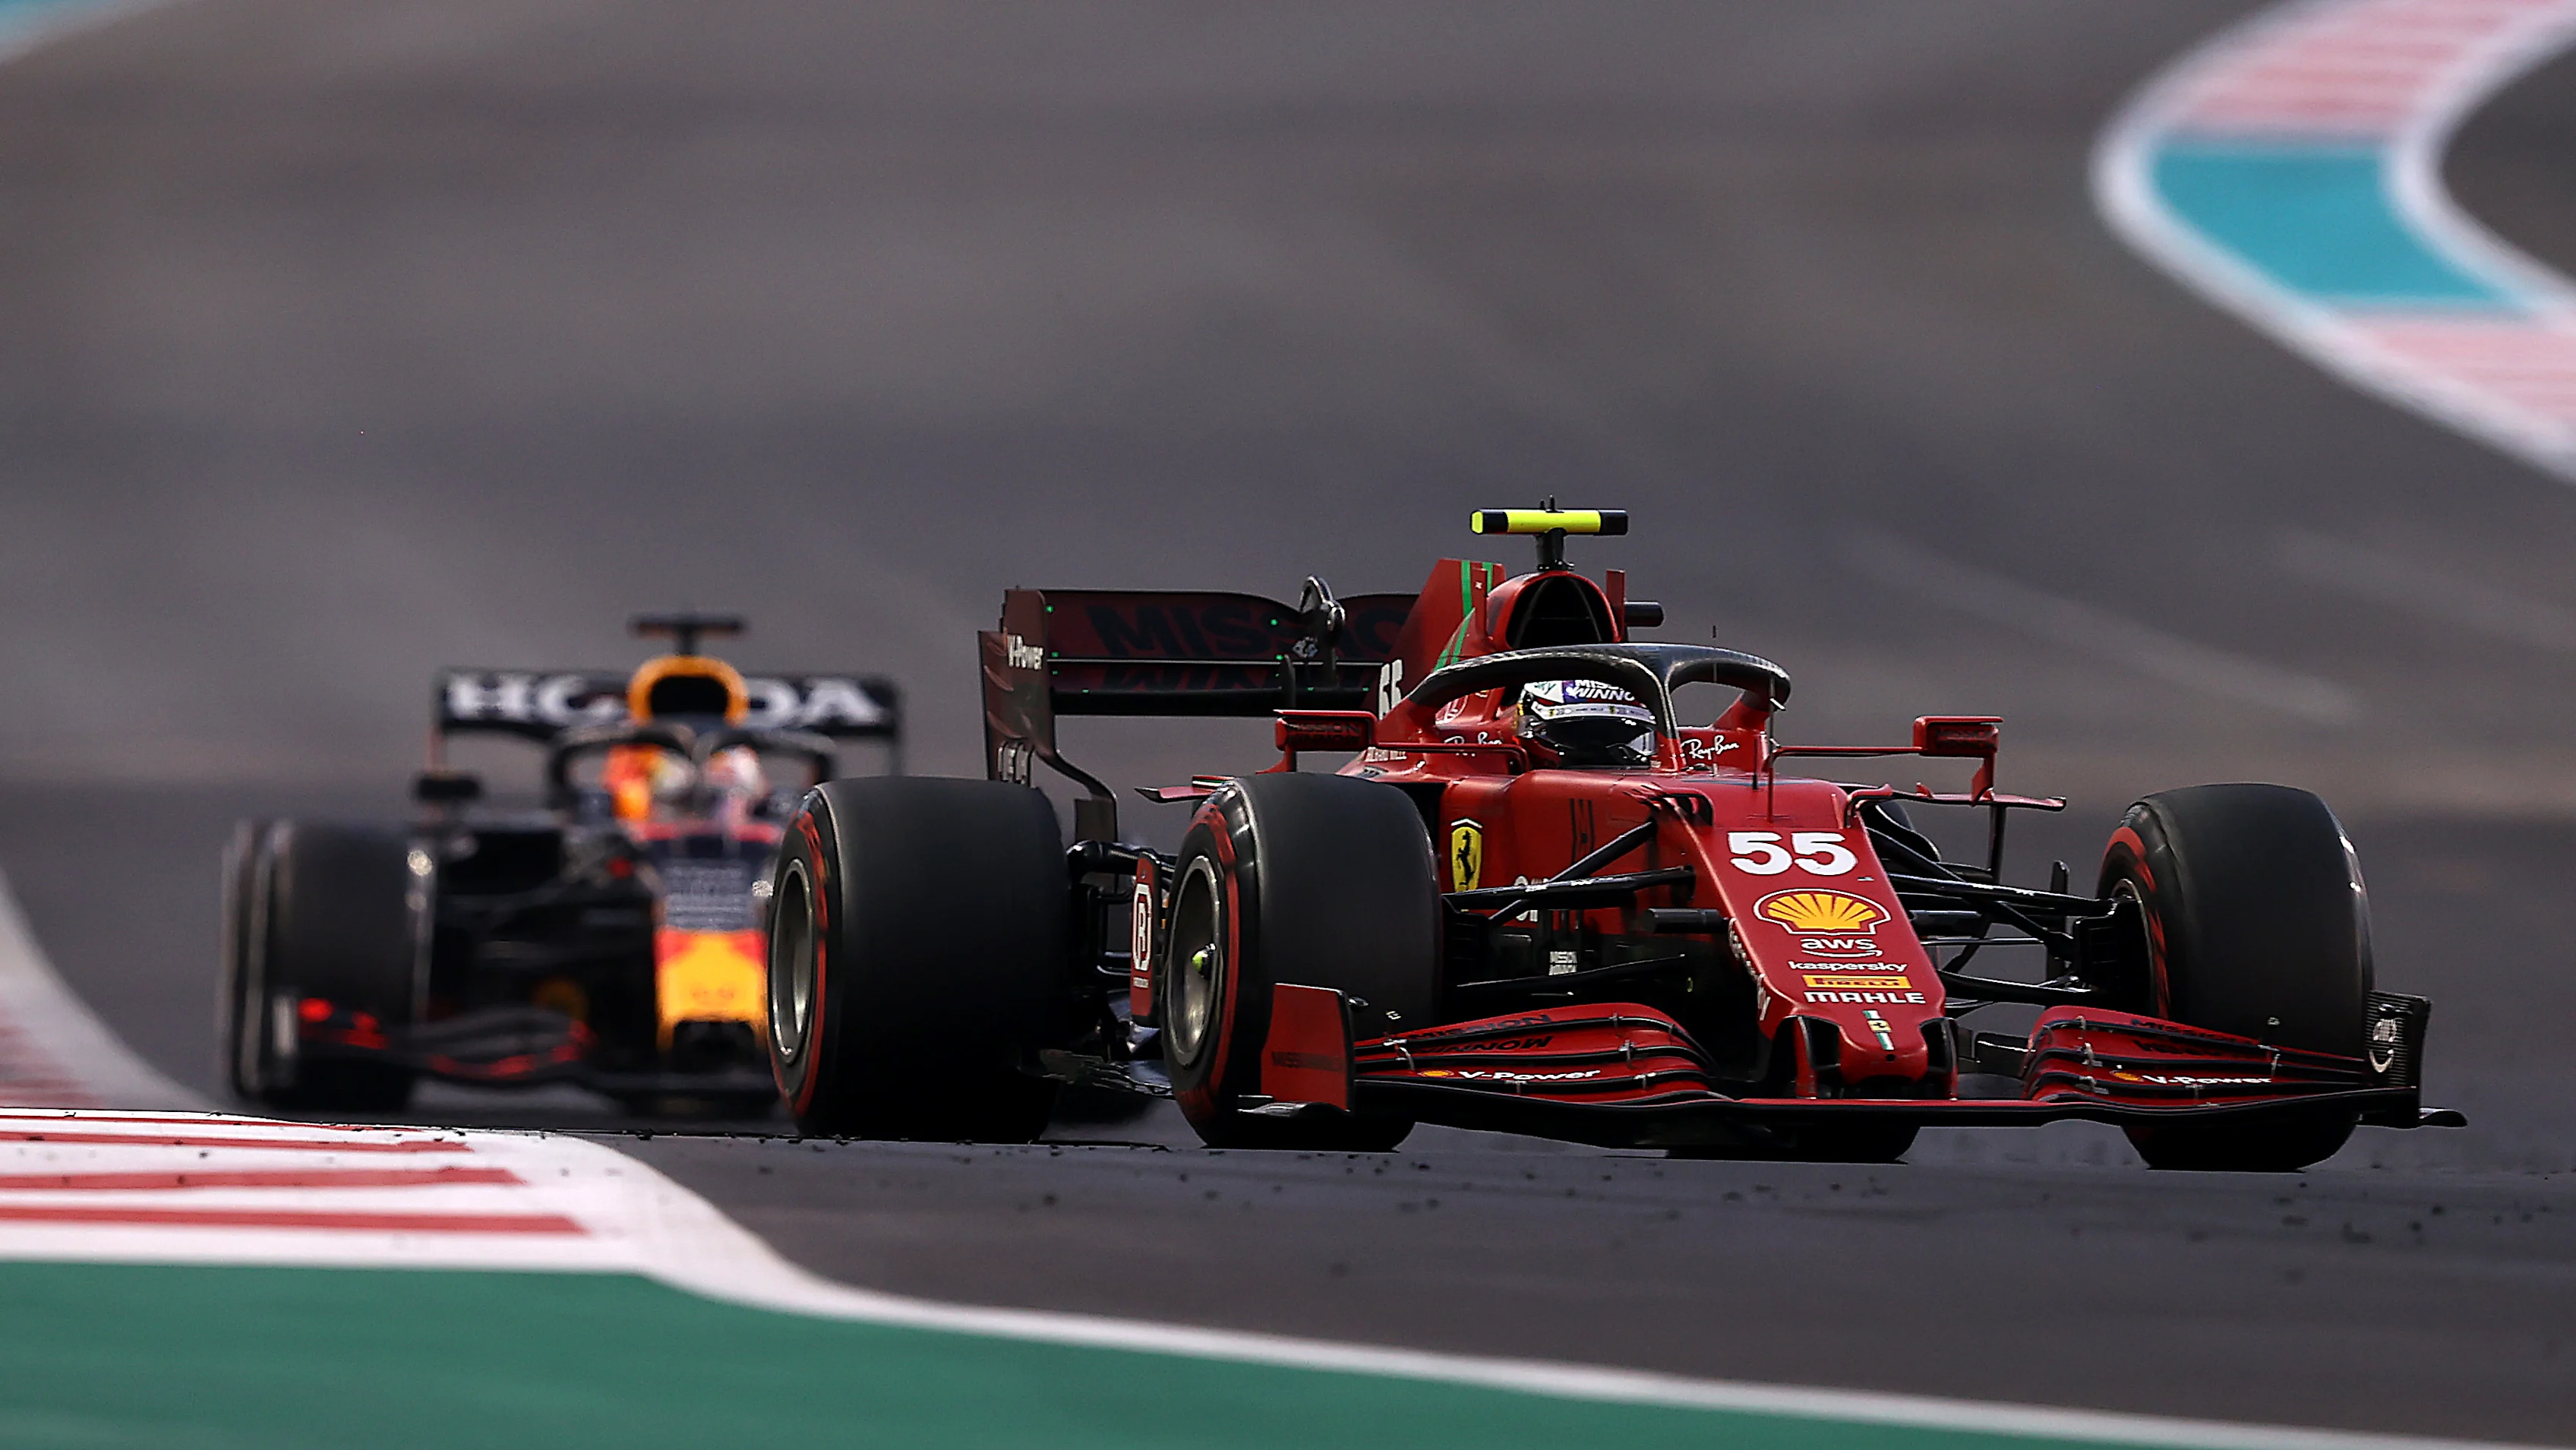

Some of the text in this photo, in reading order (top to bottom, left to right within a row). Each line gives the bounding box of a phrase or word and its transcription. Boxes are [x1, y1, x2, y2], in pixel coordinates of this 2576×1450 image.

[1088, 606, 1413, 660] MISSO
[451, 673, 885, 726] HODA
[1569, 687, 1635, 701] WINNO
[1680, 734, 1740, 760] Ray-Ban
[1728, 831, 1859, 877] 55
[1800, 938, 1877, 949] aws
[1787, 961, 1908, 972] kaspersky
[1804, 991, 1927, 1004] MAHLE
[1458, 1069, 1602, 1082] V-Power
[2142, 1074, 2272, 1085] V-Power
